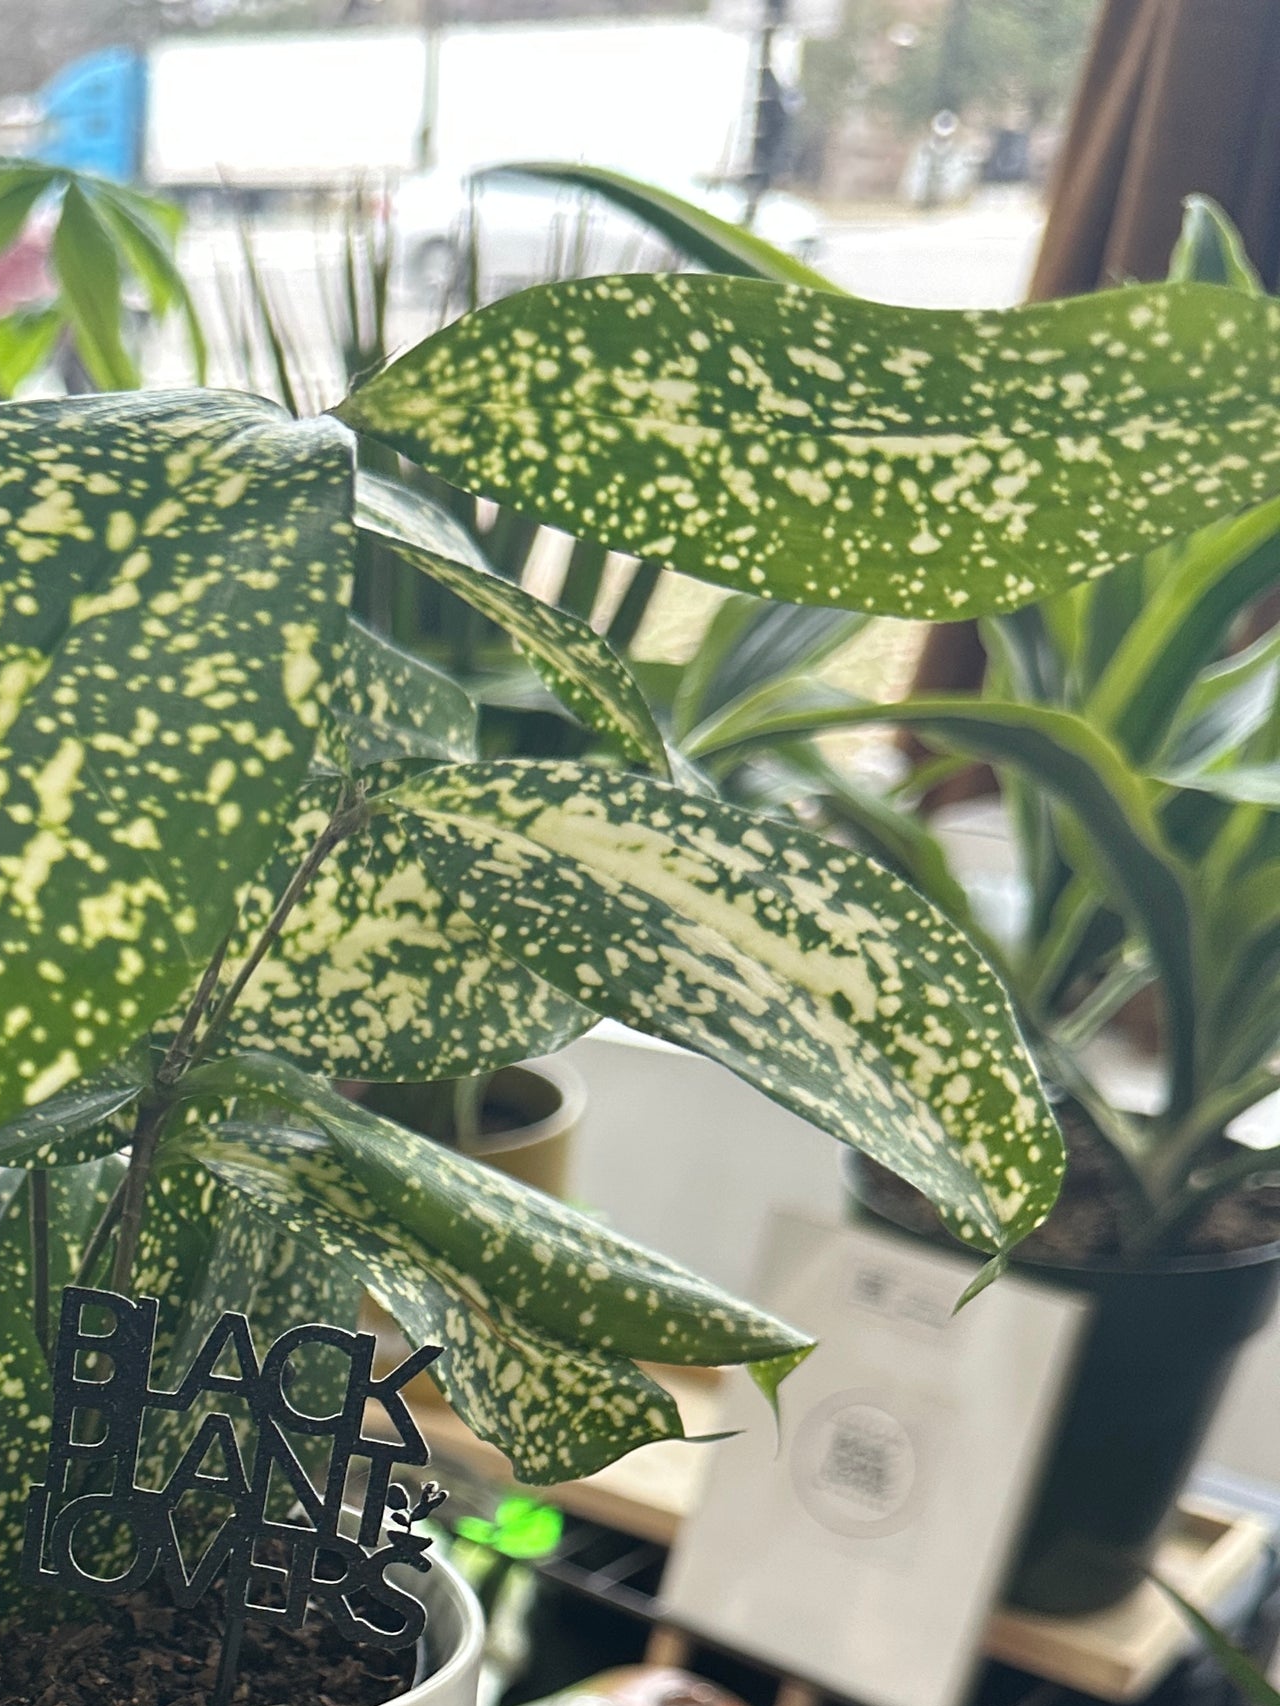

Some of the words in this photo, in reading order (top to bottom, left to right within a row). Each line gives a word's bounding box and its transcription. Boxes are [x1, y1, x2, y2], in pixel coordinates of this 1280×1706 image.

[54, 1286, 445, 1466] BLACK
[47, 1396, 430, 1548] PLANT
[23, 1484, 432, 1650] LOVERS
